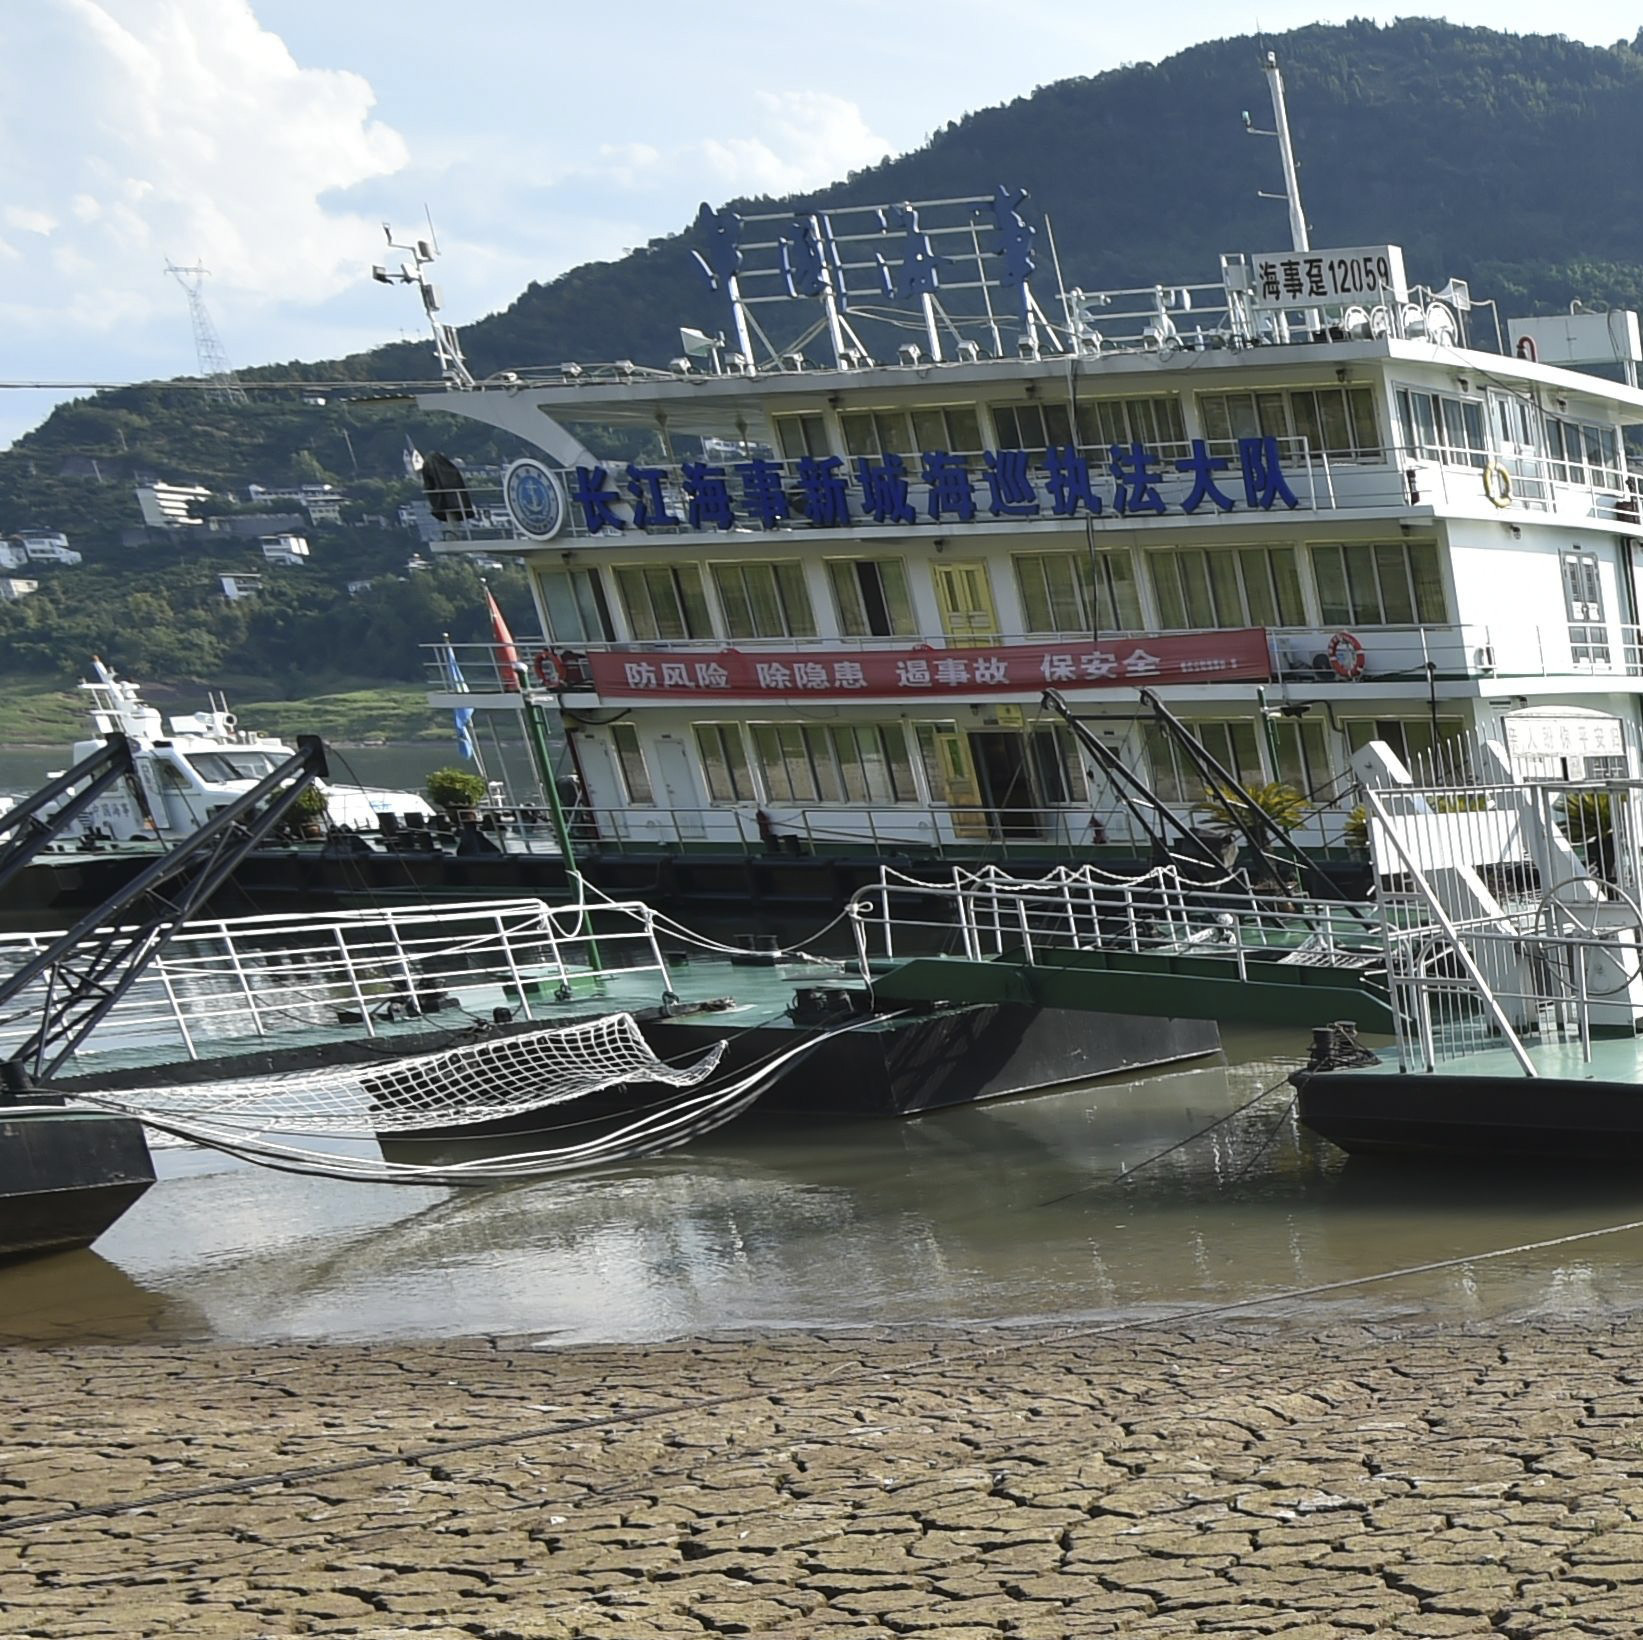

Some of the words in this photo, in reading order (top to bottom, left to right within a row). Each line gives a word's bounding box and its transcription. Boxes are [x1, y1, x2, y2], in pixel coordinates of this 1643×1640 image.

[572, 436, 1299, 534] 长江海事新城海巡执法大队
[624, 661, 731, 690] 防风险
[755, 660, 869, 690] 除隐患
[895, 656, 1011, 688] 遏事故
[1041, 648, 1161, 682] 保安全
